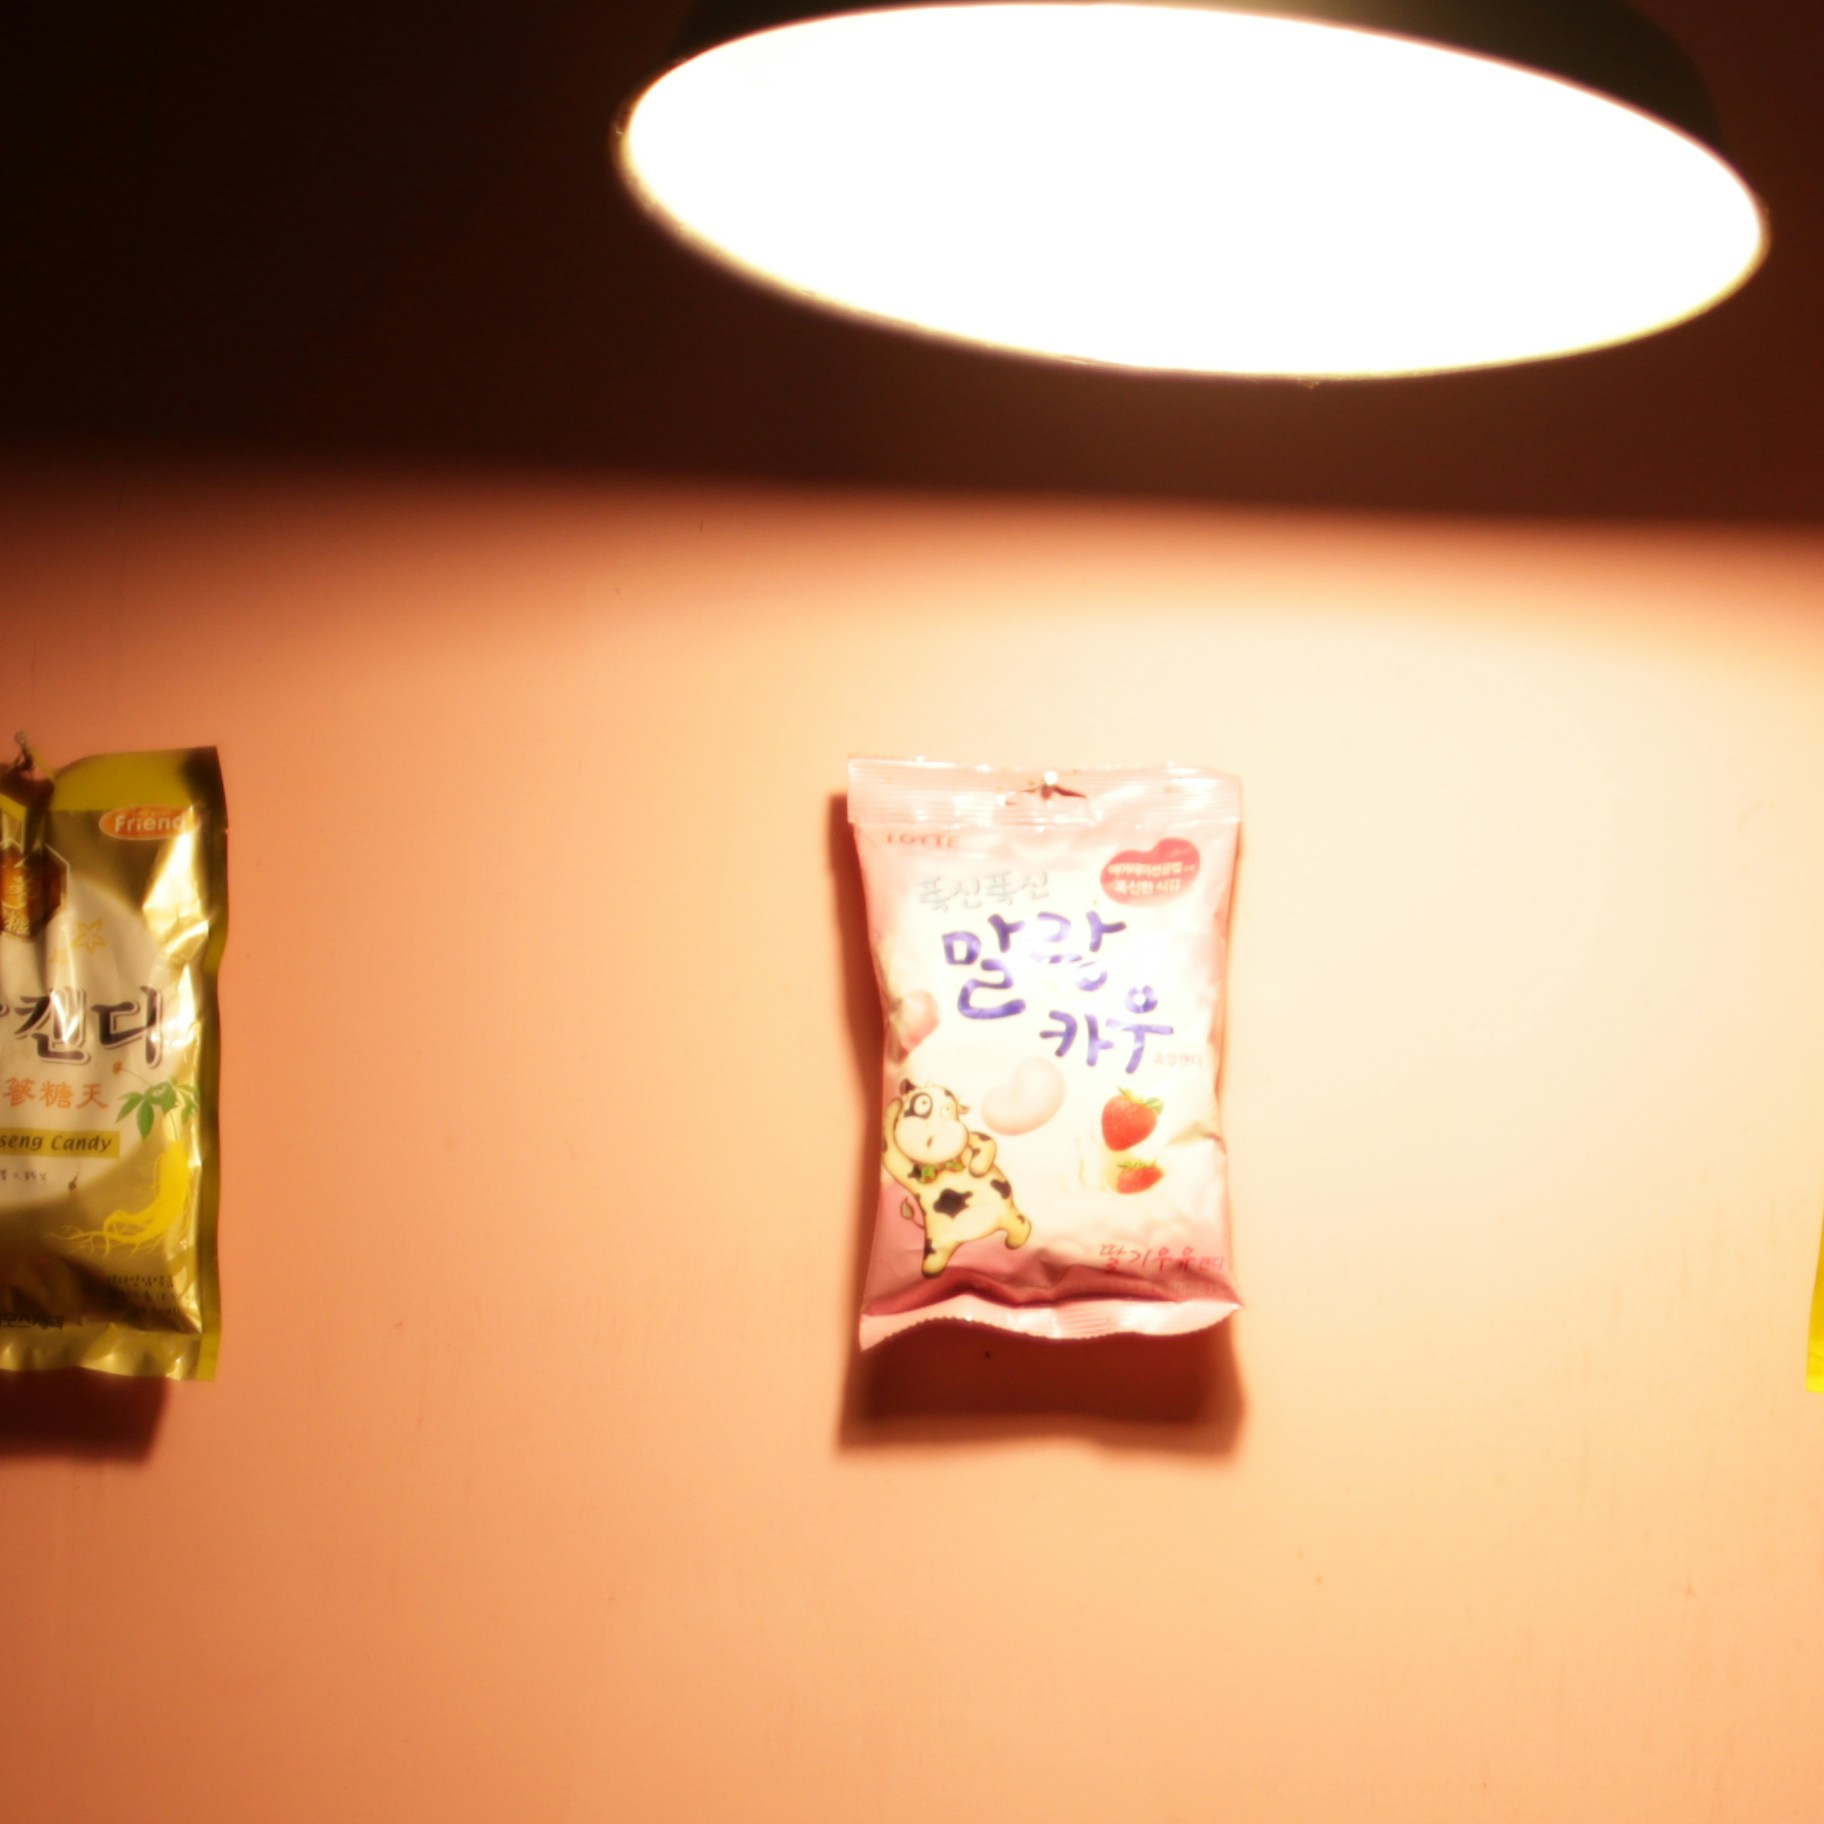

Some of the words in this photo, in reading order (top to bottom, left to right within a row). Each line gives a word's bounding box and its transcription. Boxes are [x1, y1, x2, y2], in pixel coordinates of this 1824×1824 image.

[941, 910, 1128, 1021] 말랑
[1039, 983, 1175, 1075] 카우
[50, 1133, 113, 1154] Candy
